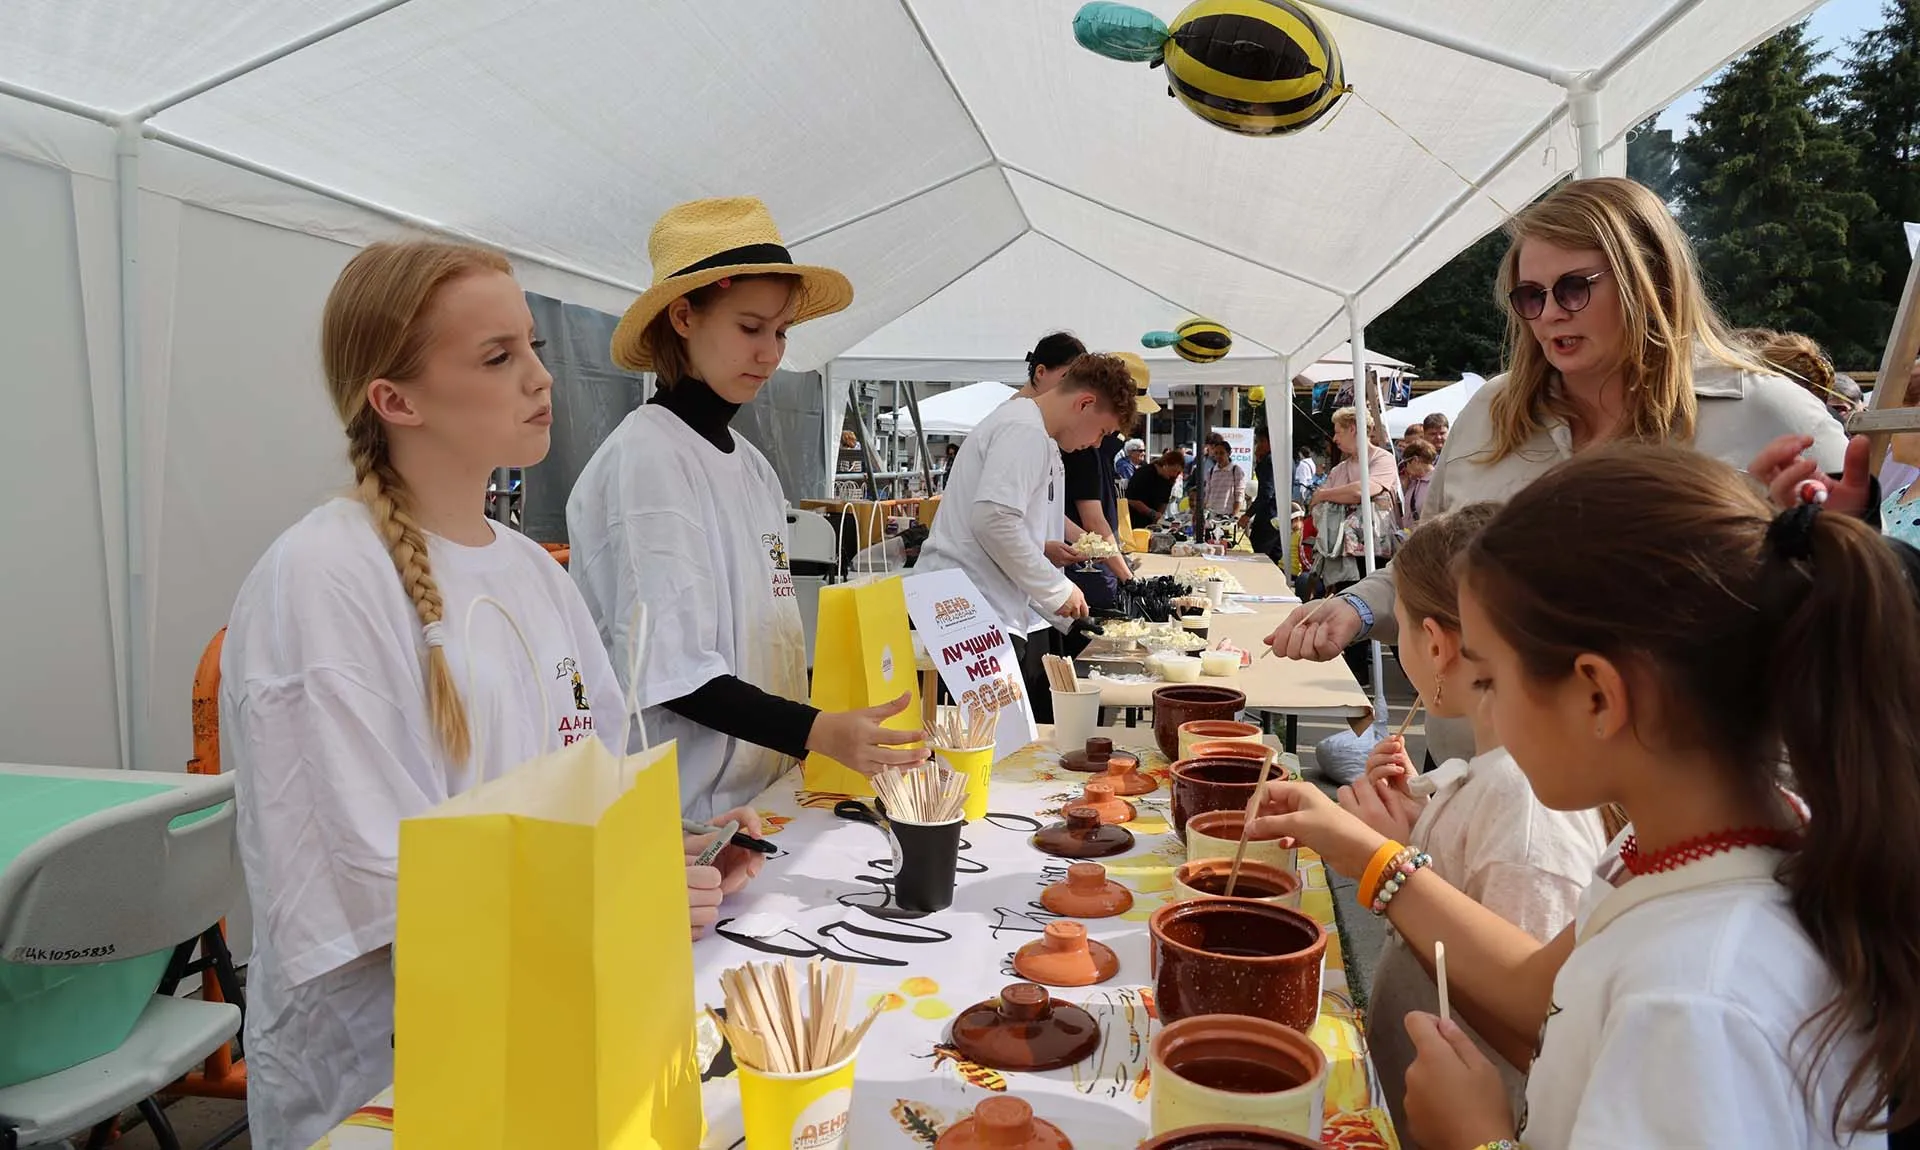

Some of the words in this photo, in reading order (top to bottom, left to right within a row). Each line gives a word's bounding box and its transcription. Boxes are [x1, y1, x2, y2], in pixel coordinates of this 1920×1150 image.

[935, 597, 970, 618] ДЕНЬ
[942, 624, 1005, 666] ЛУЧШИЙ
[965, 653, 1001, 682] МЁД
